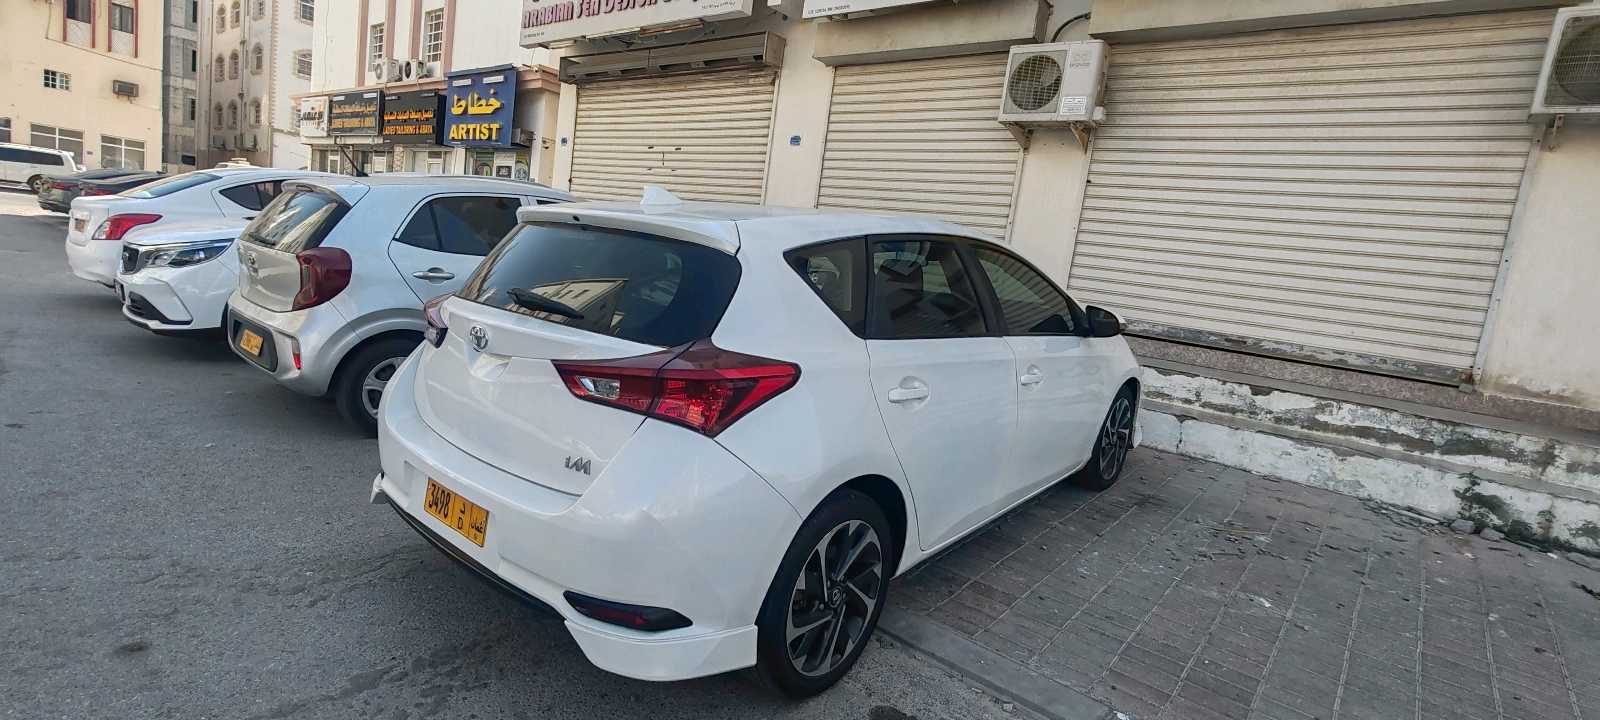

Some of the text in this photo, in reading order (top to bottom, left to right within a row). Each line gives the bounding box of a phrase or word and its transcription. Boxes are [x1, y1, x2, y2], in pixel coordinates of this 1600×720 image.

[451, 88, 503, 115] خطاط
[449, 123, 500, 141] ARTIST
[428, 482, 451, 519] 3498
[457, 516, 464, 530] D
